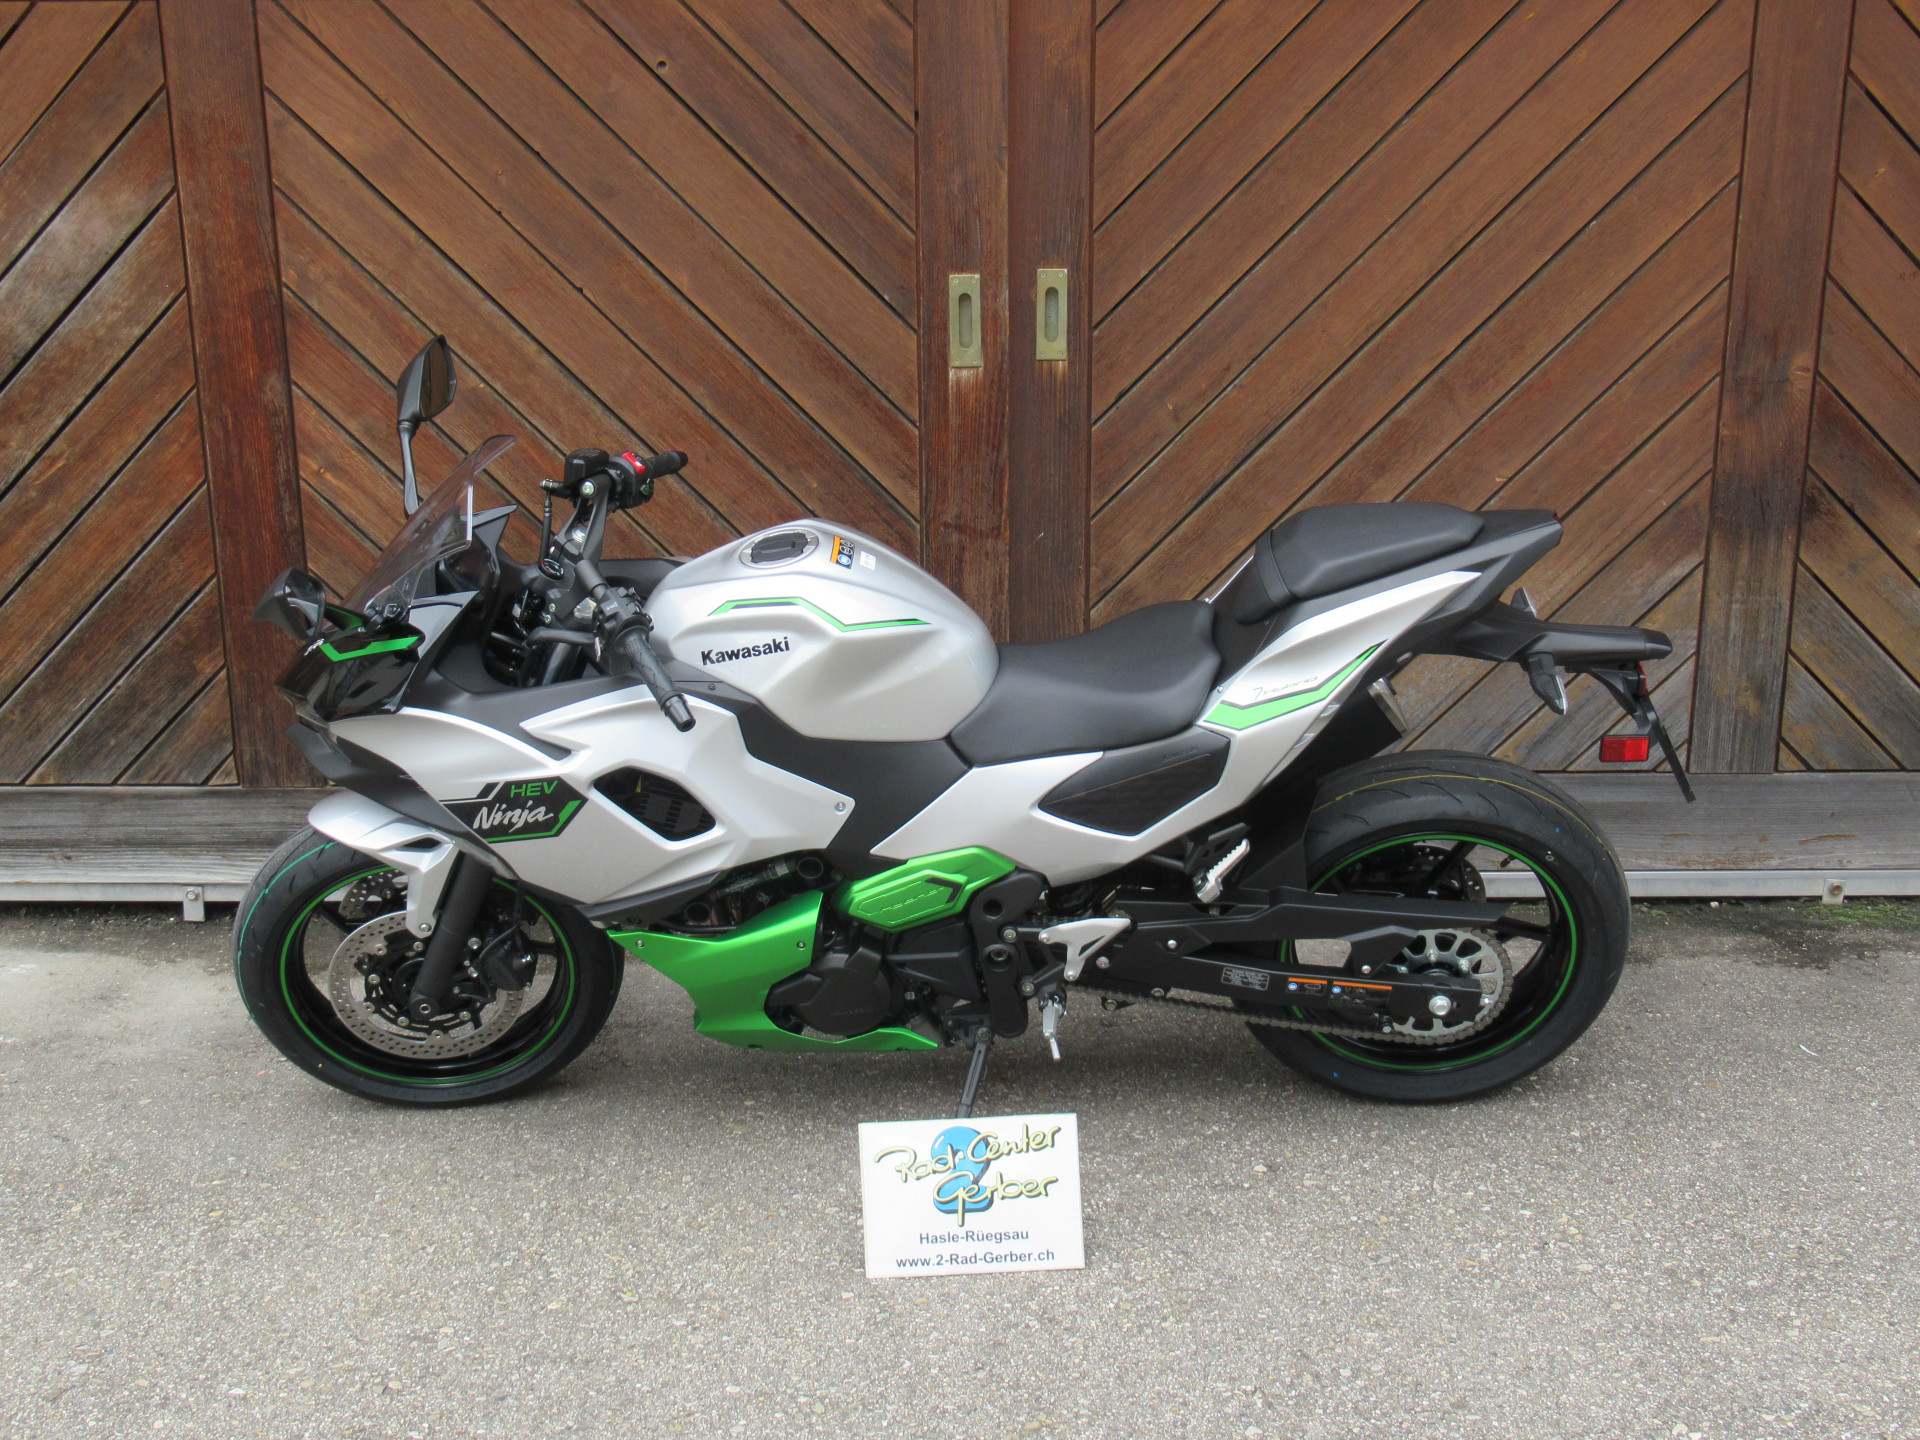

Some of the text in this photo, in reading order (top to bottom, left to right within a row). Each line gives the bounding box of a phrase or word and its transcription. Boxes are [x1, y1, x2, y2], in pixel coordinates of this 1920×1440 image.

[701, 636, 790, 666] Kawasaki
[509, 780, 559, 799] HEV
[472, 800, 554, 833] Ninja
[933, 1171, 1058, 1227] Gerber
[918, 1229, 1030, 1246] Hasle-Rüegsau
[895, 1249, 1056, 1268] www.2-Rad-Gerber.ch
